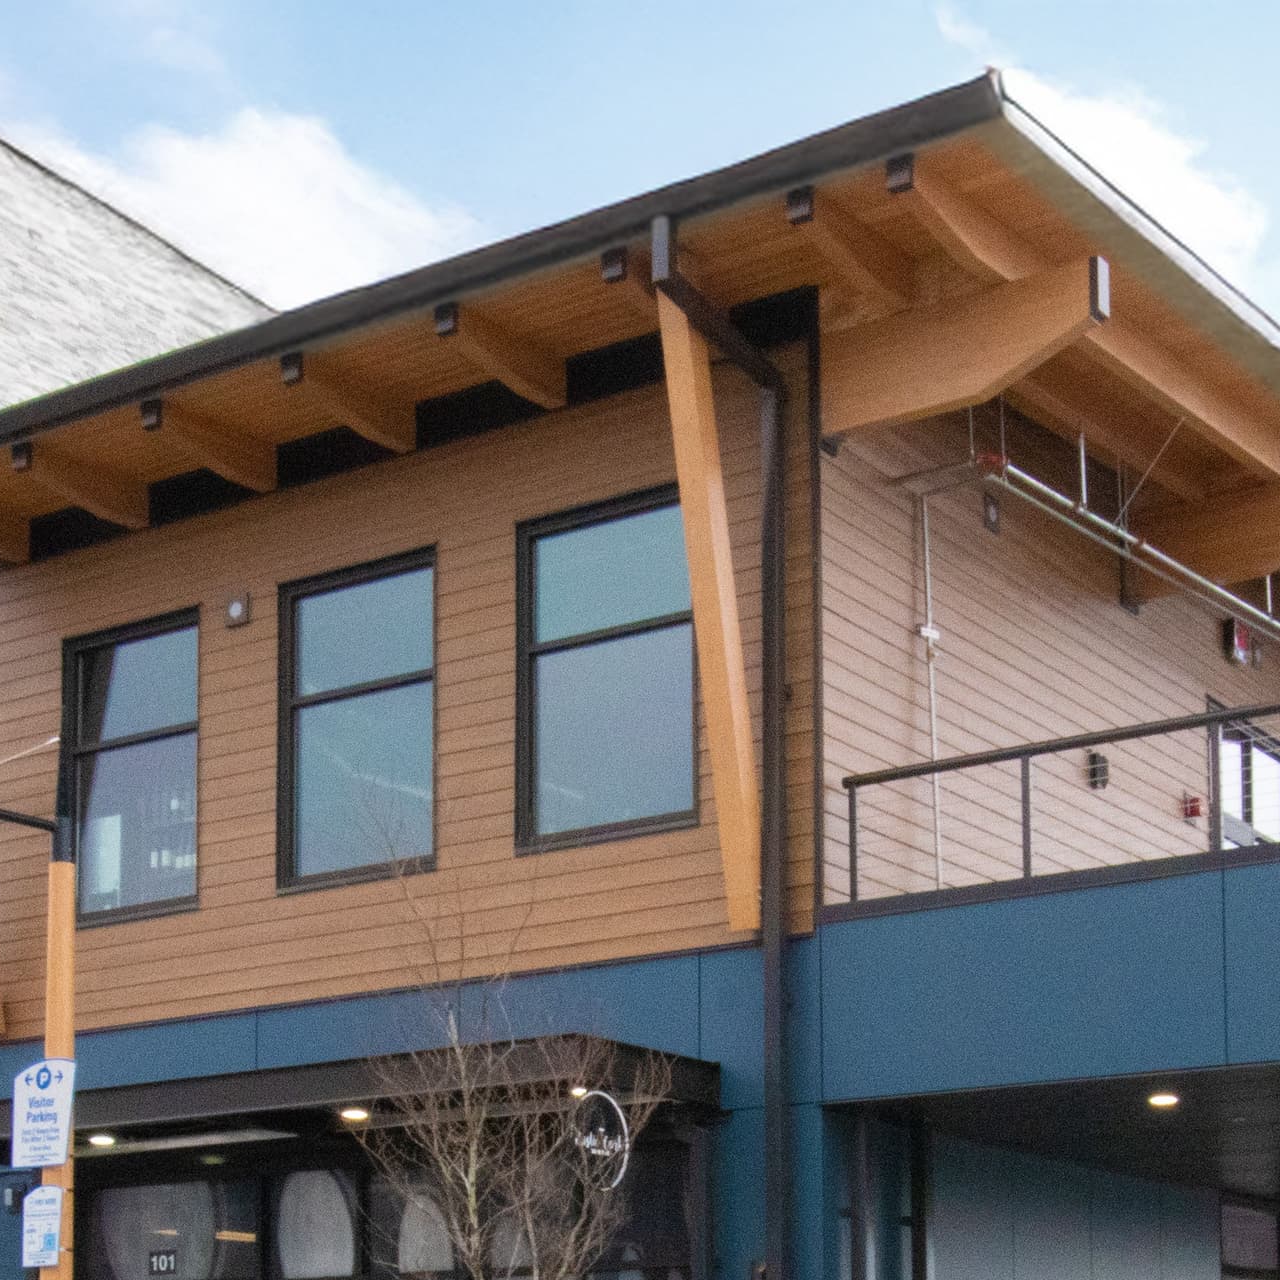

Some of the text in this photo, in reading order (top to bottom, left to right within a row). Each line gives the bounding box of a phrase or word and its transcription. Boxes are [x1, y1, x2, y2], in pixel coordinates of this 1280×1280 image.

[28, 1096, 55, 1108] Visitor
[26, 1111, 58, 1124] Parking
[151, 1254, 175, 1271] 101
